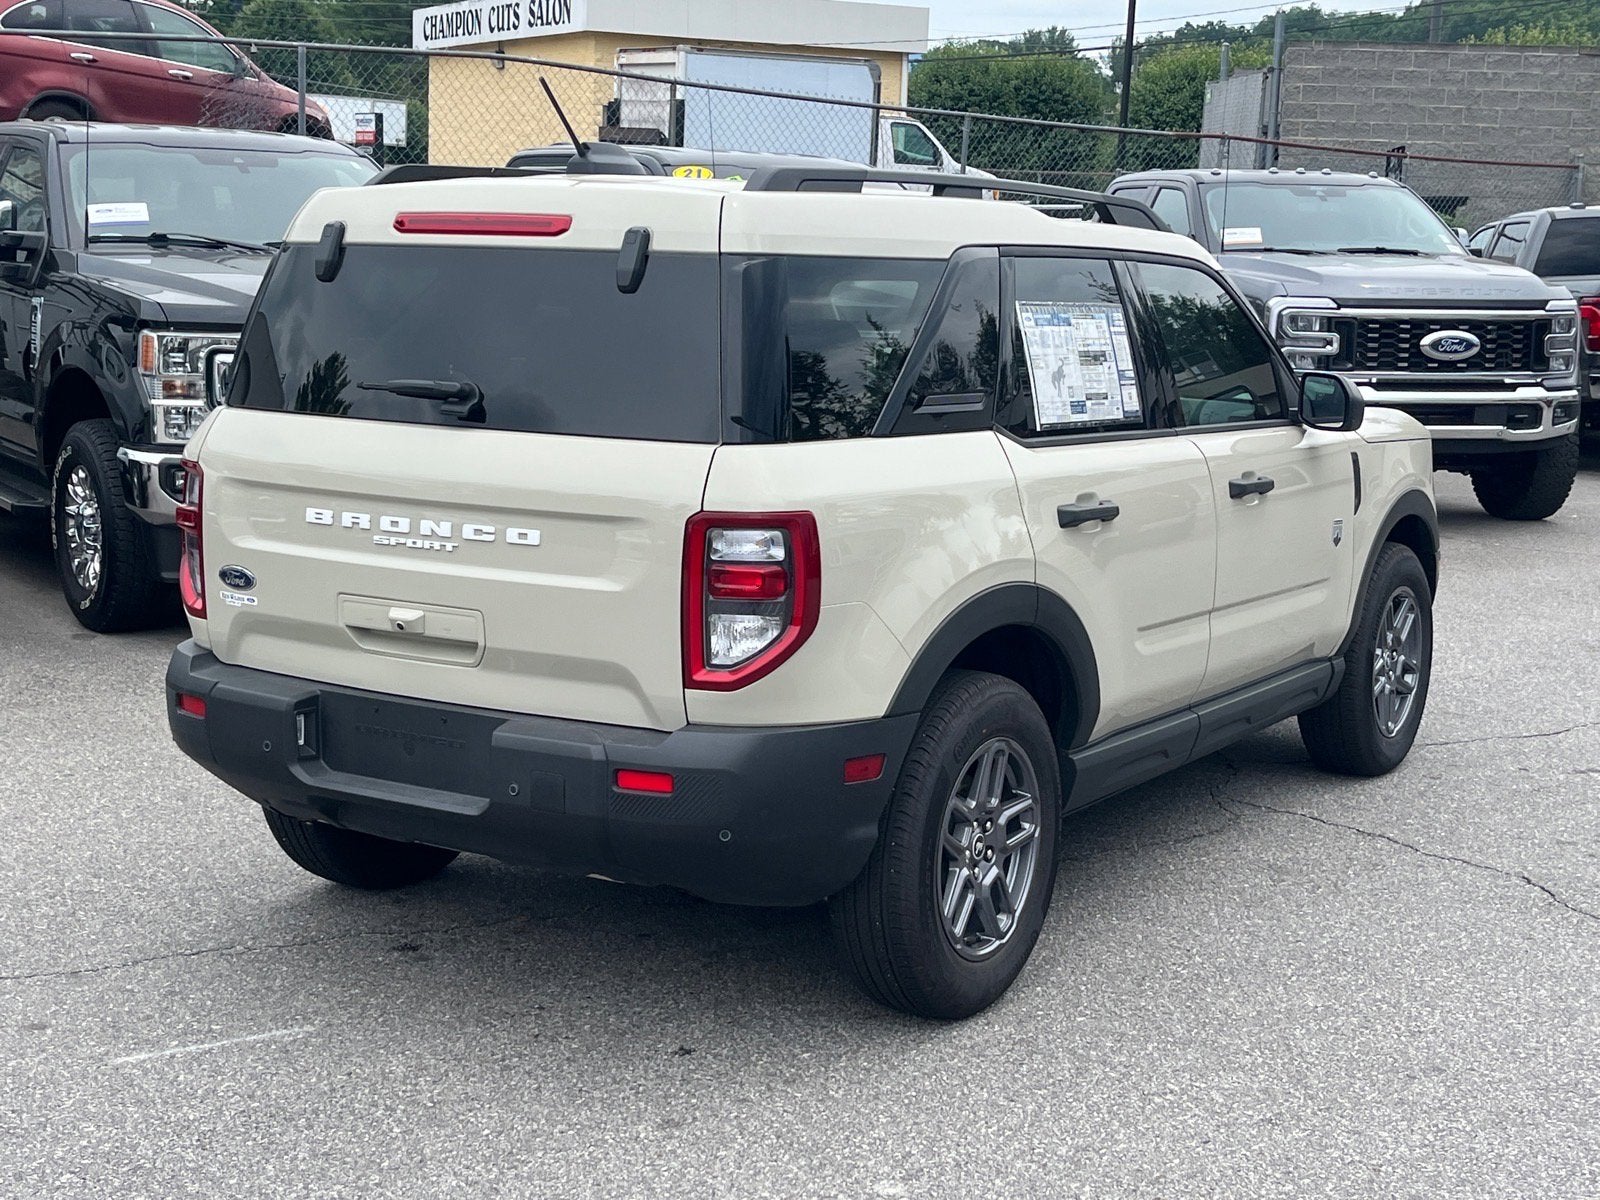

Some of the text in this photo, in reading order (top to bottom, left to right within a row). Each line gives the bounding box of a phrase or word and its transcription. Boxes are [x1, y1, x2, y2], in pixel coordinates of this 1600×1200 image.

[423, 0, 571, 42] CHAMPION CUTS SALON
[1438, 338, 1466, 352] Ford
[305, 507, 541, 546] BRONCO
[373, 535, 459, 552] SPORT
[225, 570, 247, 586] Ford
